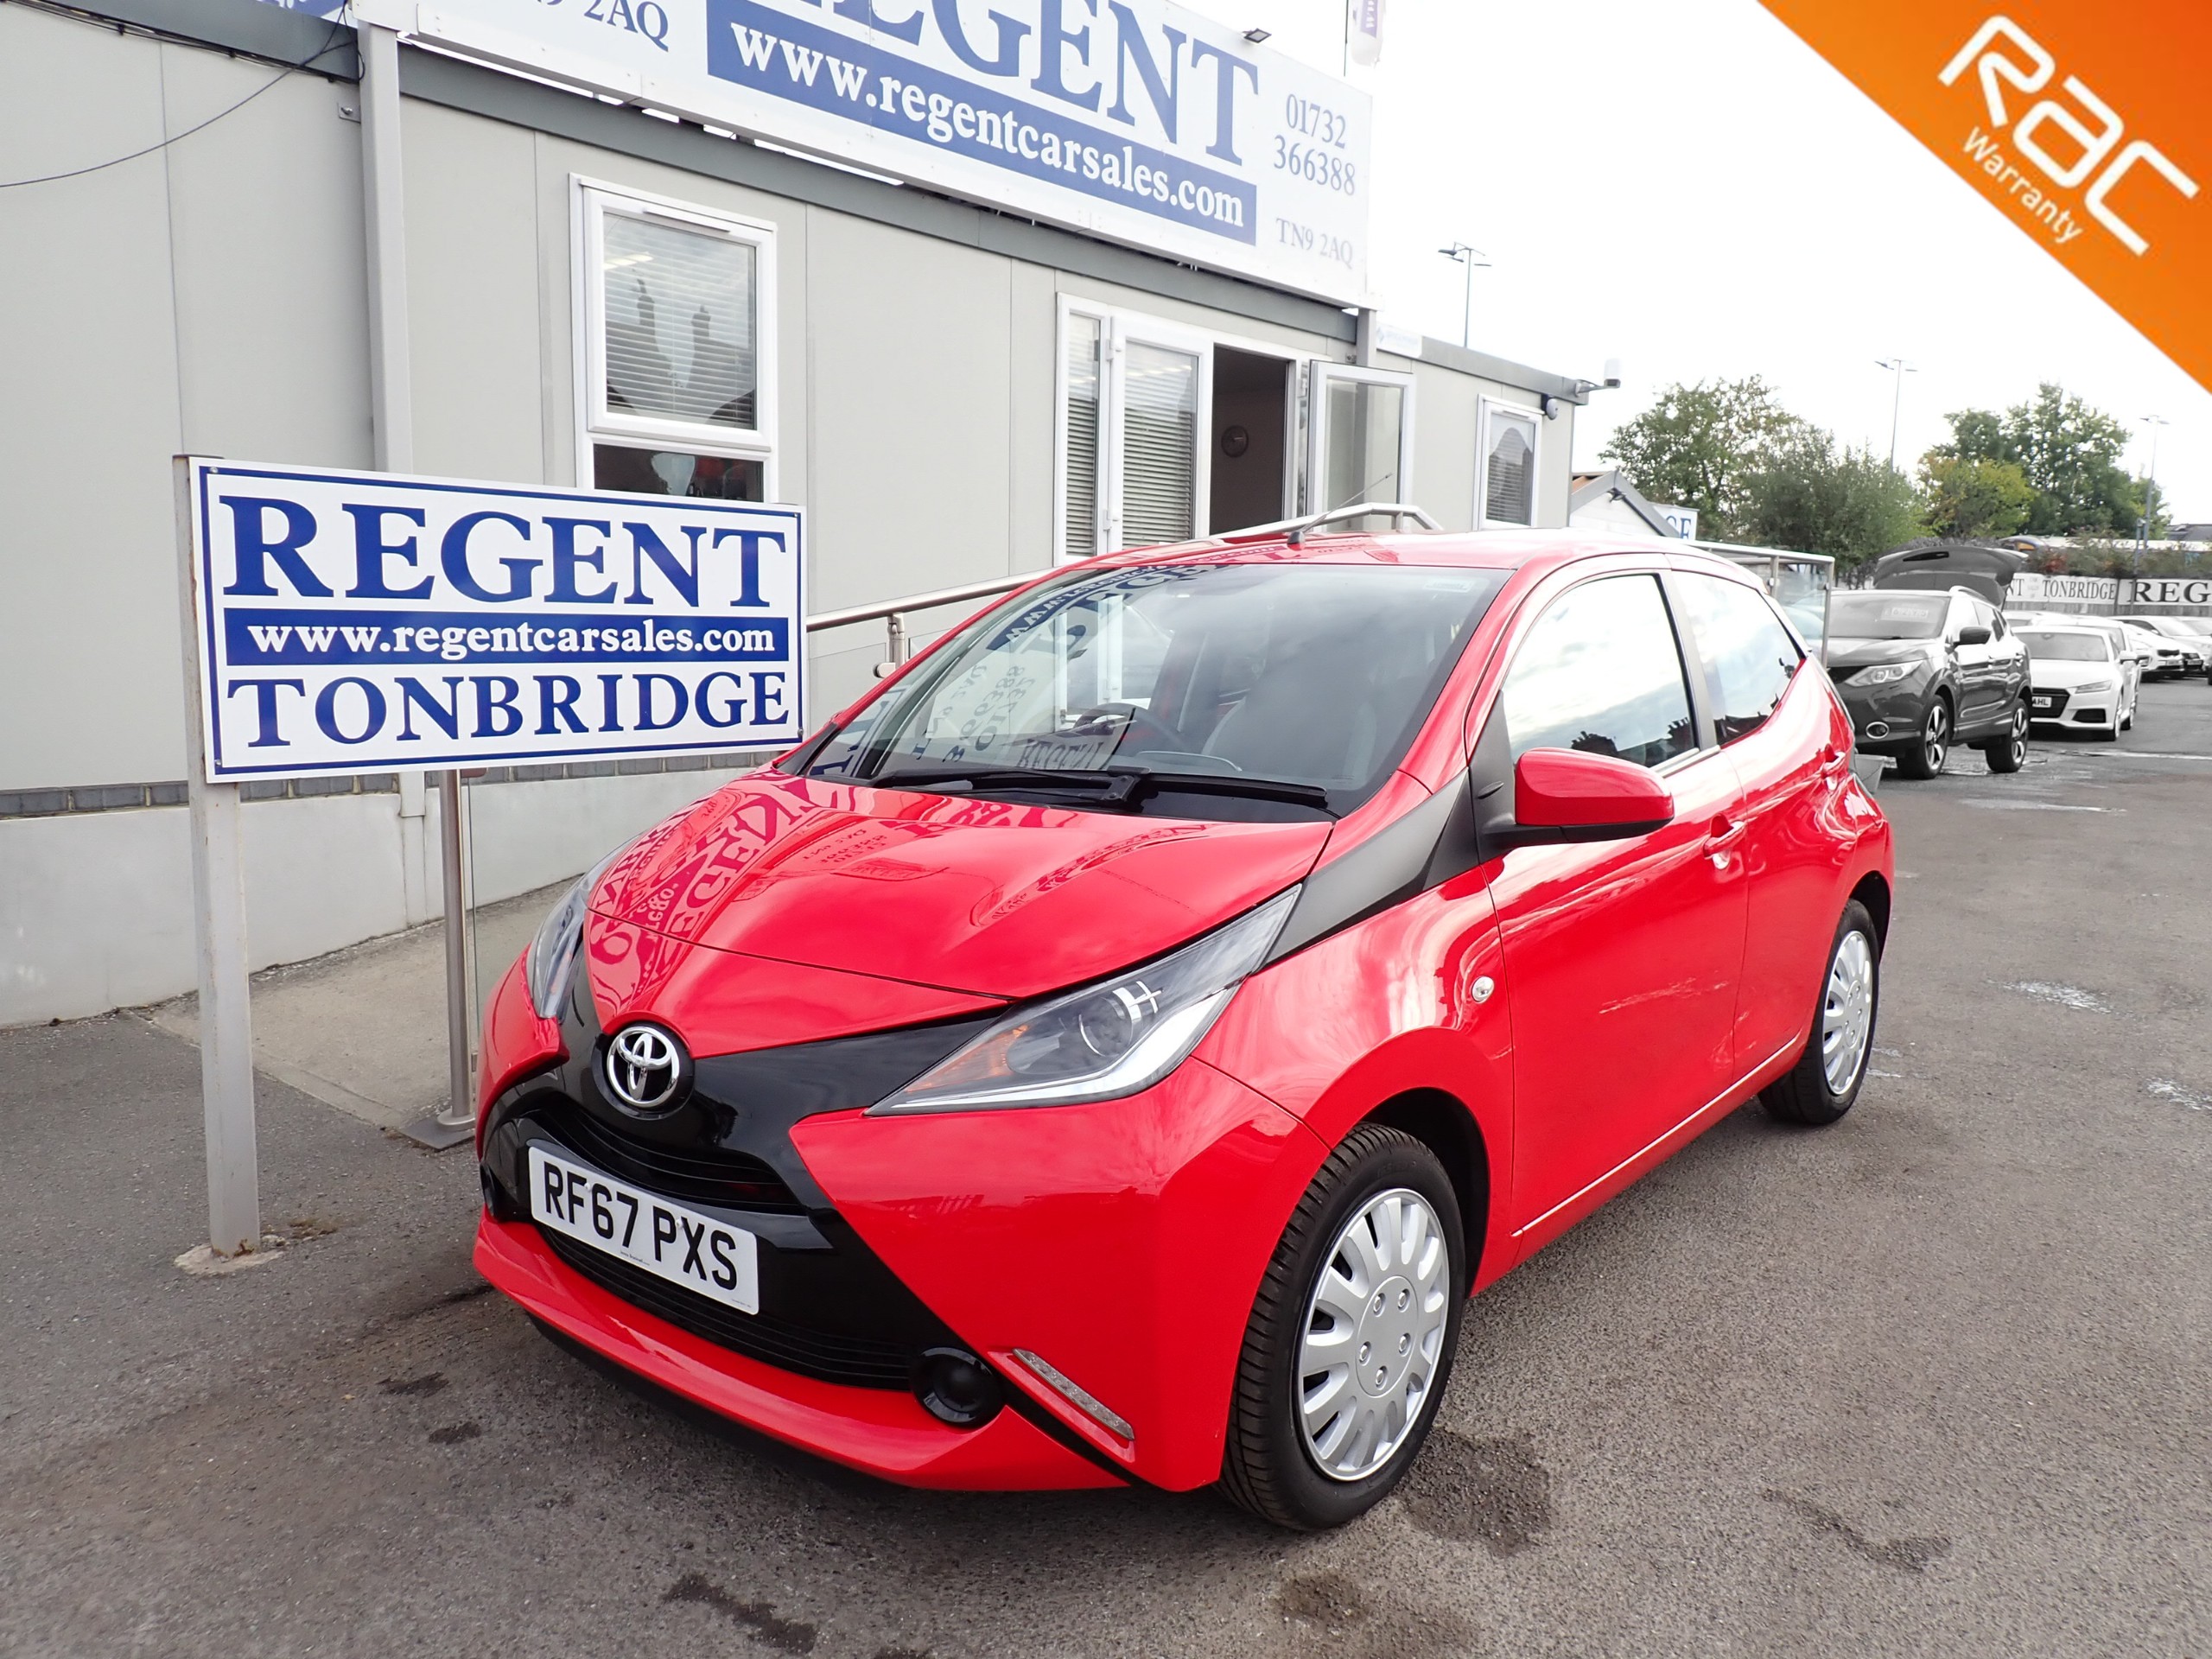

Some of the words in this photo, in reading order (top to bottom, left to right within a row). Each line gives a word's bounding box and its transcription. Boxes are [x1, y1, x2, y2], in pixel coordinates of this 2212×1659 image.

[731, 22, 1243, 227] www.regentcarsales.com
[1286, 93, 1346, 149] 01732
[1274, 134, 1356, 196] 366388
[1275, 218, 1314, 251] TN9
[1319, 233, 1353, 270] 2AQ
[219, 494, 786, 607] REGENT
[2042, 579, 2117, 601] TONBRIDGE
[248, 619, 774, 661] www.regentcarsales.com
[227, 671, 790, 748] TONBRIDGE
[543, 1160, 639, 1249] RF67
[652, 1205, 737, 1291] PXS
